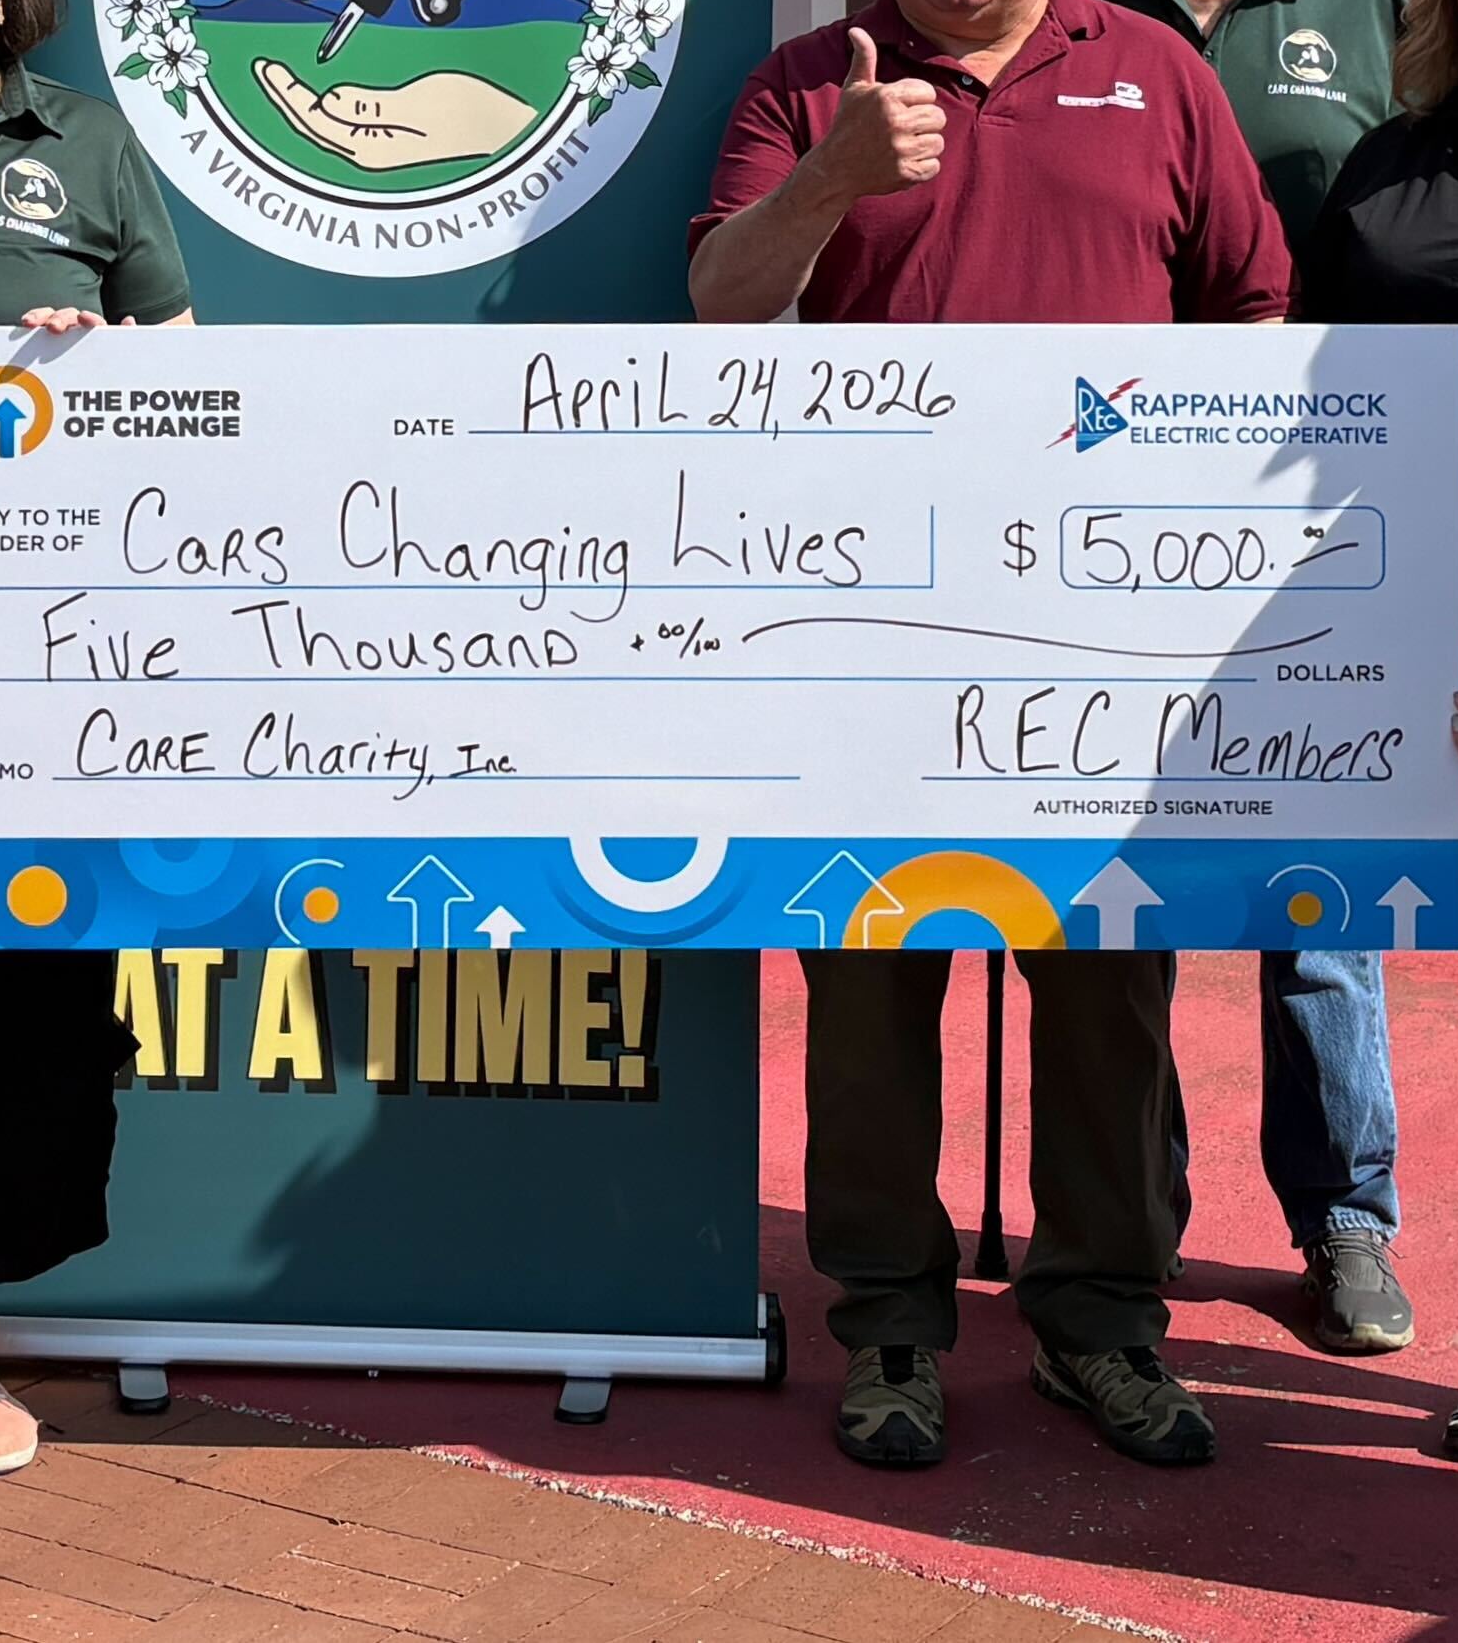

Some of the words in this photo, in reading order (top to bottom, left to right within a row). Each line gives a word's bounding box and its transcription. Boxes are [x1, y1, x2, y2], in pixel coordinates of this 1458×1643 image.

[181, 127, 208, 156] A
[206, 149, 361, 248] VIRGINIA
[374, 131, 592, 250] NON-PROFIT
[63, 390, 124, 413] THE
[131, 390, 241, 413] POWER
[708, 357, 779, 441] 24,
[803, 359, 956, 425] 2026
[1131, 393, 1387, 418] RAPPAHANNOCK
[63, 415, 106, 438] OF
[113, 415, 241, 438] CHANGE
[394, 419, 455, 437] DATE
[1130, 426, 1229, 445] ELECTRIC
[1236, 426, 1388, 445] COOPERATIVE
[18, 509, 49, 526] TO
[57, 509, 101, 526] THE
[52, 535, 84, 552] OF
[340, 480, 629, 622] Changing
[672, 469, 866, 588] Lives
[1003, 519, 1037, 577] $
[43, 591, 180, 682] Five
[1276, 664, 1385, 684] DOLLARS
[954, 683, 1122, 777] REC
[1156, 691, 1404, 782] Members
[242, 710, 436, 801] Charity,
[1033, 799, 1158, 816] AUTHORIZED
[1163, 799, 1273, 816] SIGNATURE
[113, 948, 224, 1077] AT
[247, 948, 324, 1080] A
[352, 948, 648, 1088] TIME!
